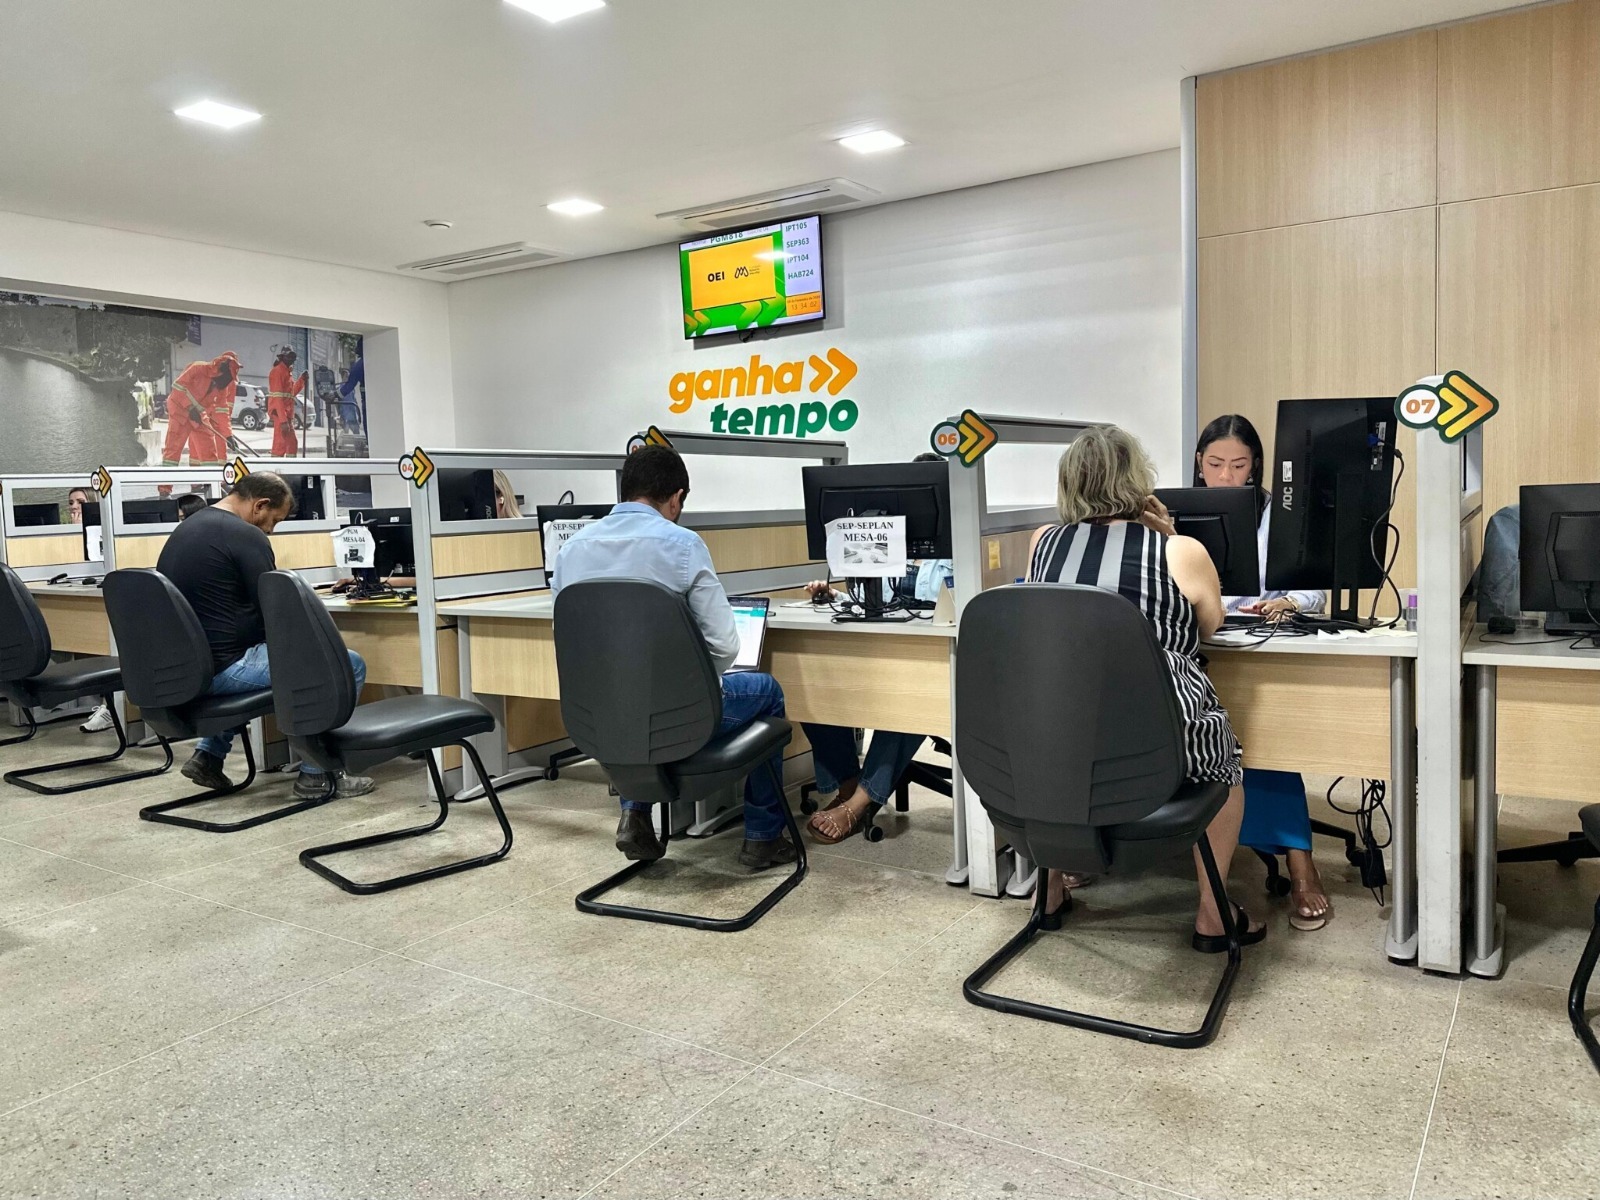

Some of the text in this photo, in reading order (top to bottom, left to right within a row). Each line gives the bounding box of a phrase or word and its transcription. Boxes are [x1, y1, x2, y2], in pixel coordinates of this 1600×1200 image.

[785, 222, 808, 232] IPT105
[786, 237, 810, 249] SEP363
[787, 254, 809, 264] IPT104
[707, 271, 725, 283] OEI
[787, 269, 814, 280] HAB724
[668, 354, 805, 414] ganha
[1405, 399, 1436, 414] 07
[710, 399, 859, 438] tempo
[937, 433, 958, 446] 06
[401, 463, 414, 473] 04
[225, 470, 234, 479] 03
[1282, 486, 1293, 511] AOC
[836, 521, 894, 530] SEP-SEPLAN
[843, 533, 888, 542] MESA-06
